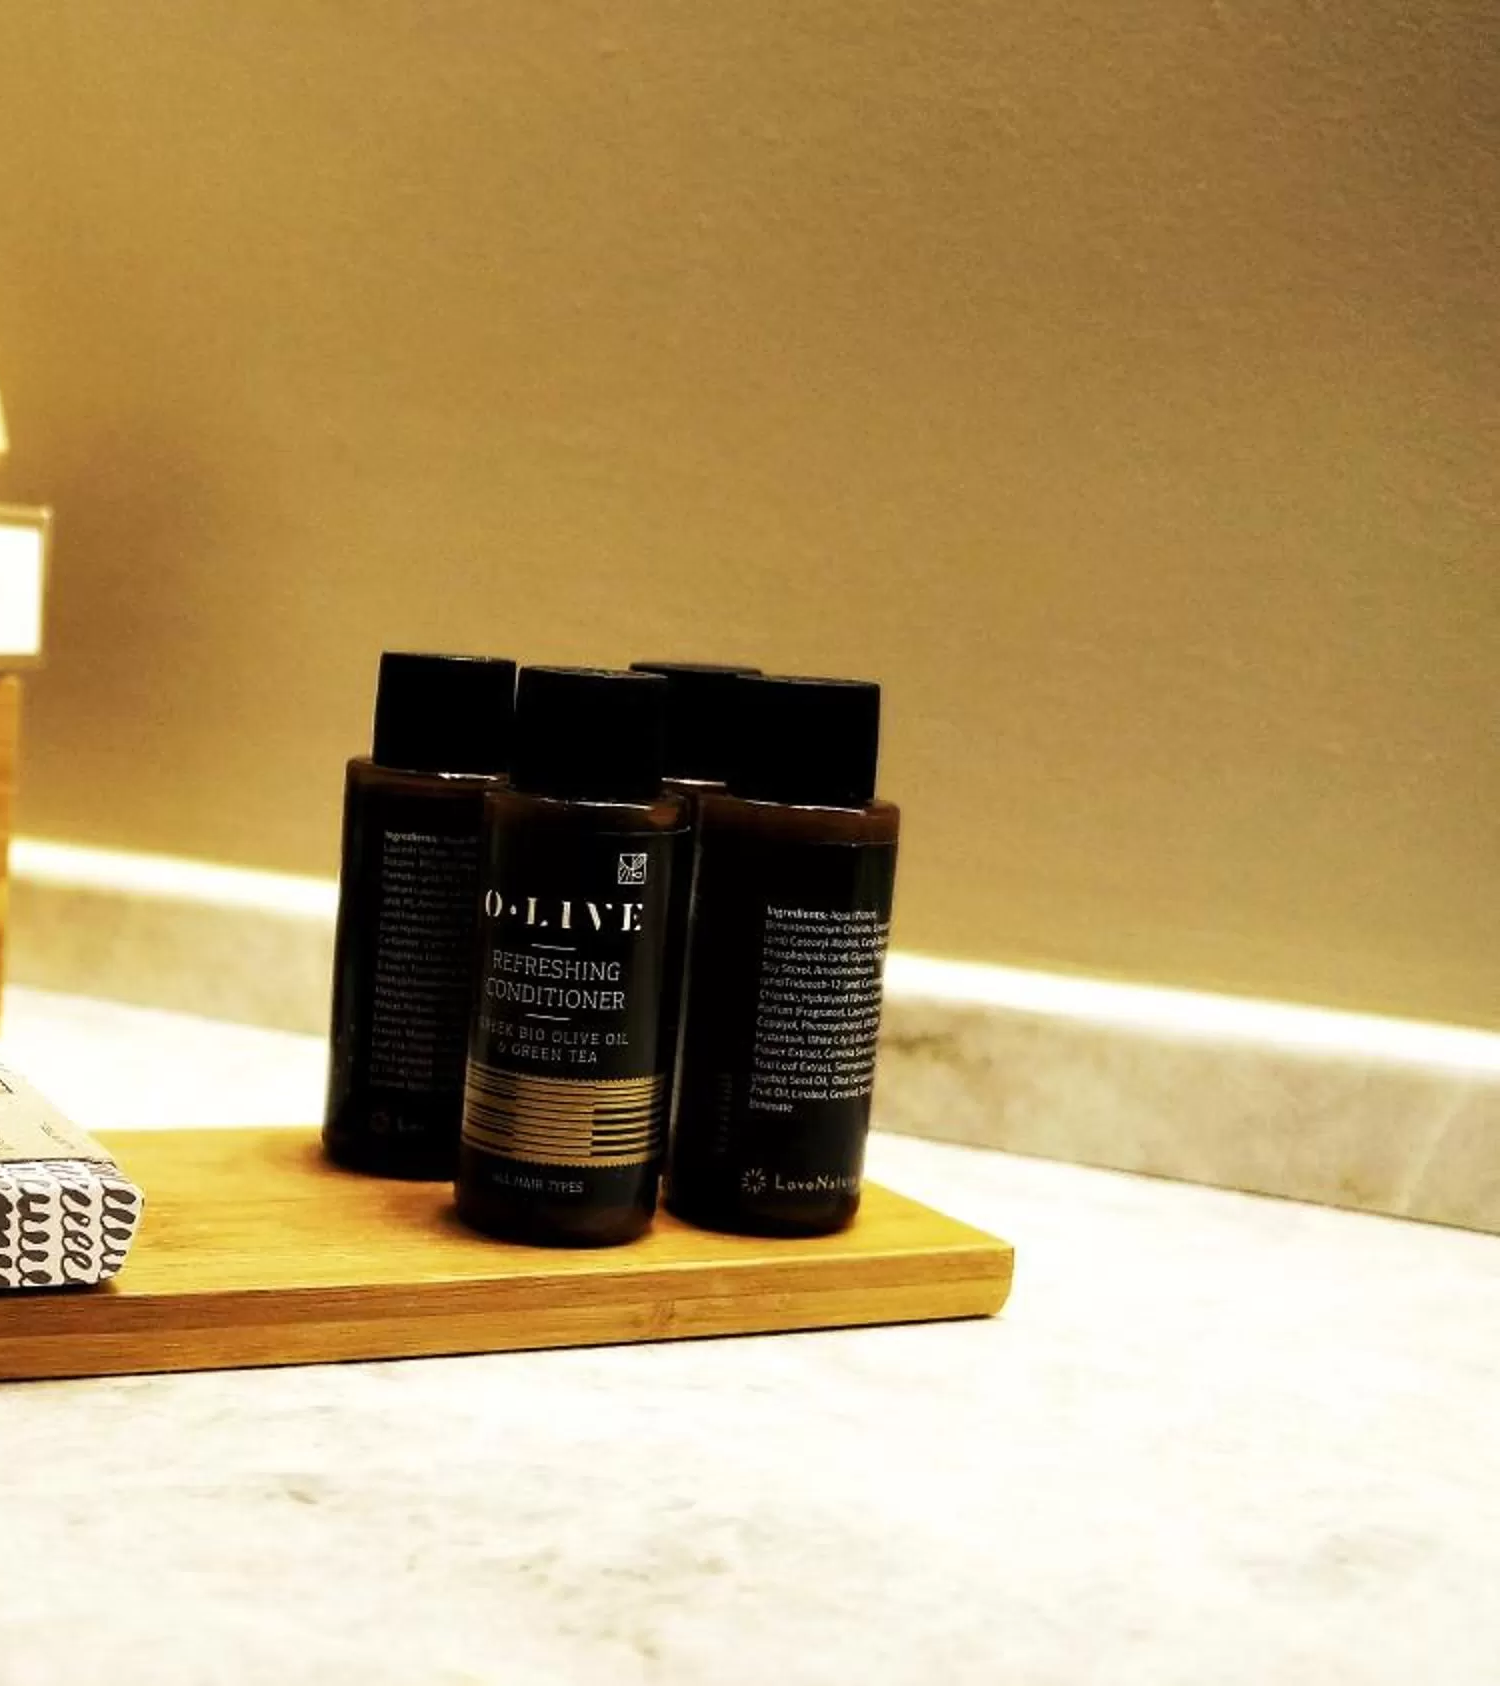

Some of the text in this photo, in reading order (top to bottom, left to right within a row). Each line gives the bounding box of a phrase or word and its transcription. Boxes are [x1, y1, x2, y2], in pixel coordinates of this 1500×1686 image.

[492, 949, 622, 982] REFRESHING
[485, 977, 626, 1010] CONDITIONER
[518, 1025, 546, 1041] BIO
[551, 1030, 601, 1045] OLIVE
[604, 1032, 630, 1045] OIL
[511, 1043, 563, 1062] GREEN
[568, 1048, 599, 1064] TEA
[547, 1179, 586, 1195] TYPES
